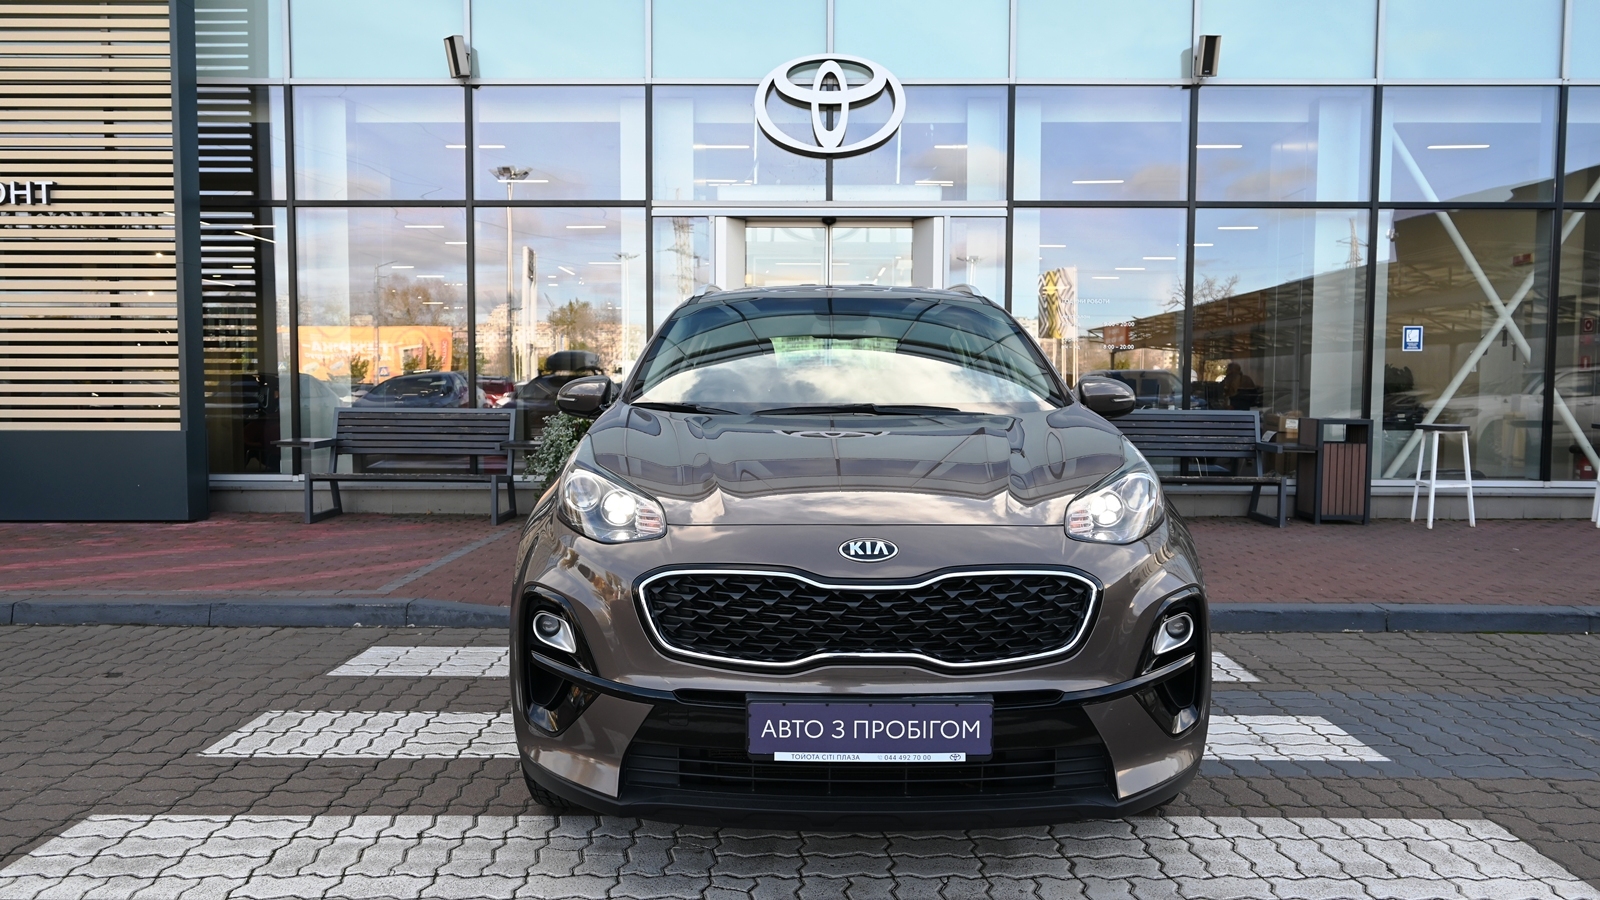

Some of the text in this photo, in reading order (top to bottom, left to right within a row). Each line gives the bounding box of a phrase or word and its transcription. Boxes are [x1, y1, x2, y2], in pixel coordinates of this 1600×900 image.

[0, 181, 54, 205] НТ
[849, 541, 889, 556] KIA
[761, 719, 824, 739] АВТО
[854, 719, 980, 739] ПРОБІГОМ
[791, 752, 820, 761] ТОЙОТА
[836, 753, 861, 761] ПЛАЗА
[884, 753, 898, 761] 044
[899, 753, 911, 761] 492
[912, 753, 922, 761] 70
[923, 753, 932, 761] 00
